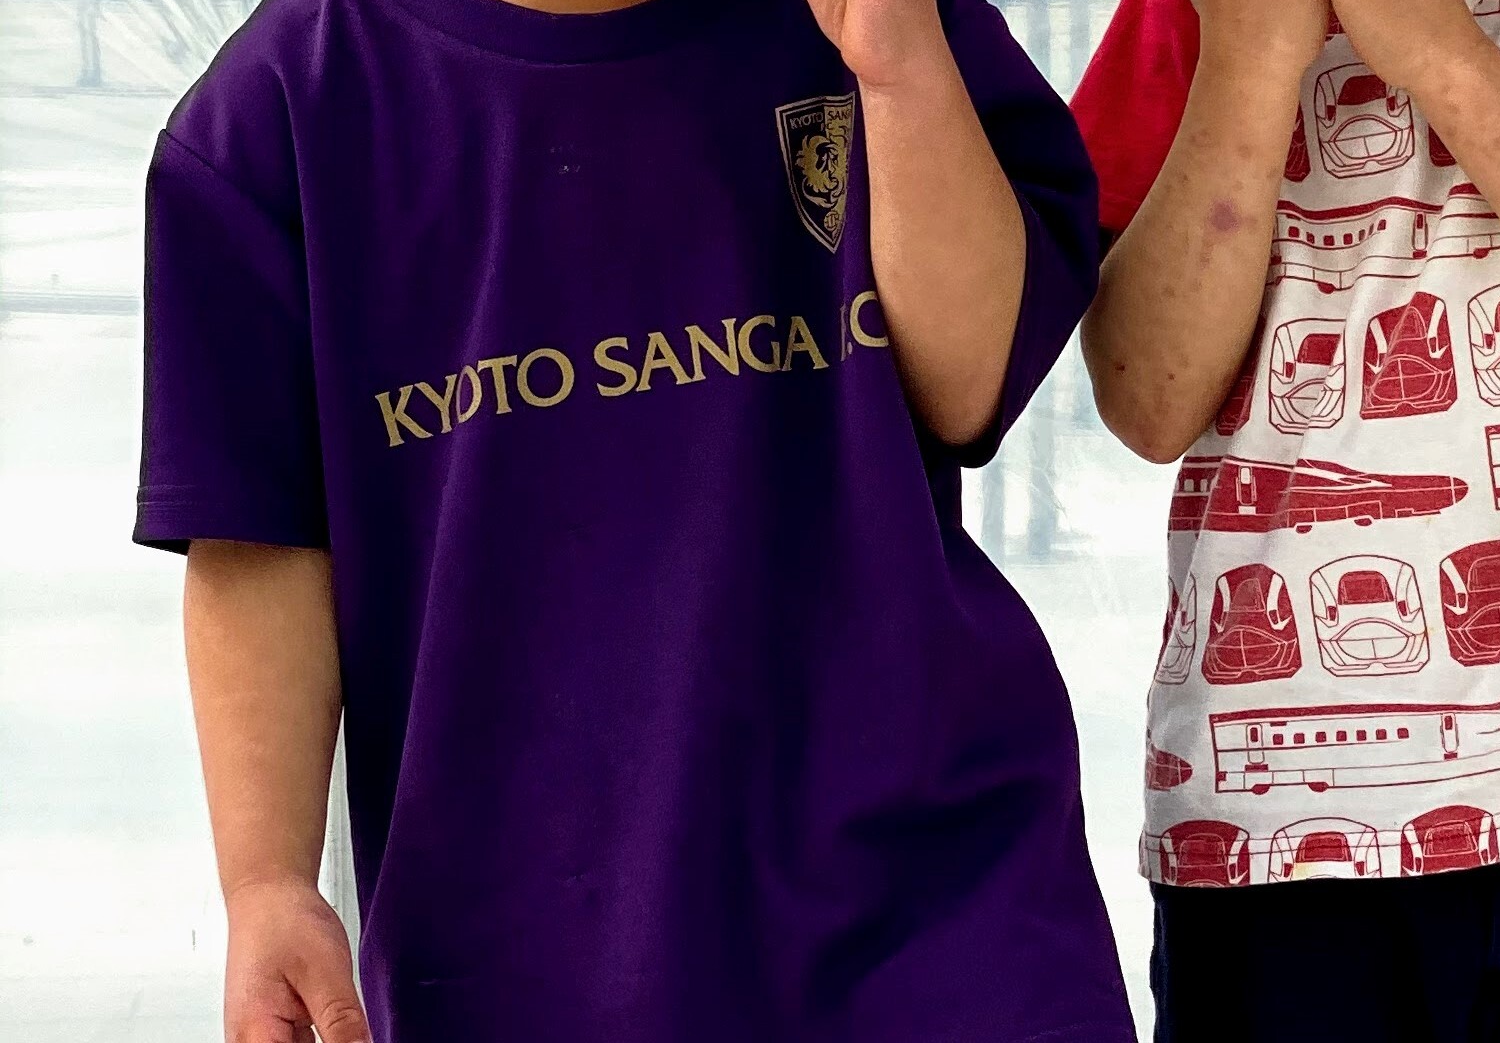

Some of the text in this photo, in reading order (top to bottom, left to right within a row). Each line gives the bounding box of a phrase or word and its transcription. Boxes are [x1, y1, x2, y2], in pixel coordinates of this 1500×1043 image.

[789, 112, 824, 130] KYOTO
[375, 347, 575, 447] KYOTO
[593, 314, 829, 398] SANGA
